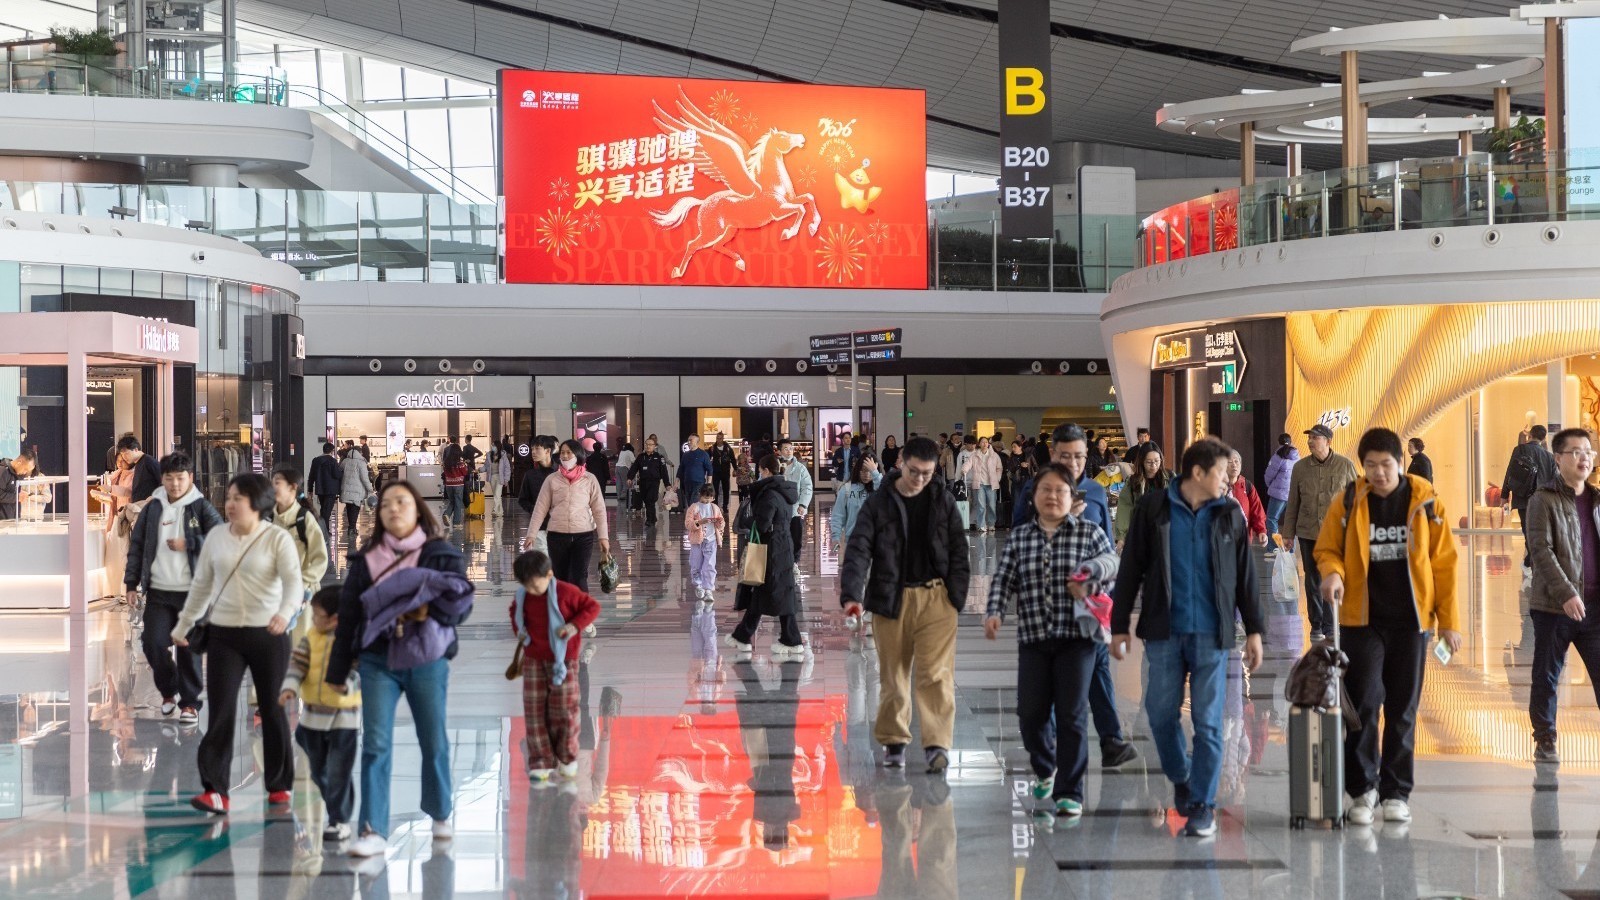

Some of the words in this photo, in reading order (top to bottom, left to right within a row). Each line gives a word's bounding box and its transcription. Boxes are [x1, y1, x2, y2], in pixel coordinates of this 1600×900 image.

[1006, 67, 1046, 115] B
[818, 118, 857, 137] 2026
[576, 129, 697, 175] 骐骥驰骋
[1005, 147, 1050, 167] B20
[574, 162, 695, 209] 兴享适程
[1005, 187, 1050, 207] B37
[506, 213, 637, 250] EOY
[801, 252, 885, 289] LE
[398, 395, 465, 407] CHANEL
[748, 393, 808, 405] CHANEL
[1369, 523, 1409, 543] Jeep
